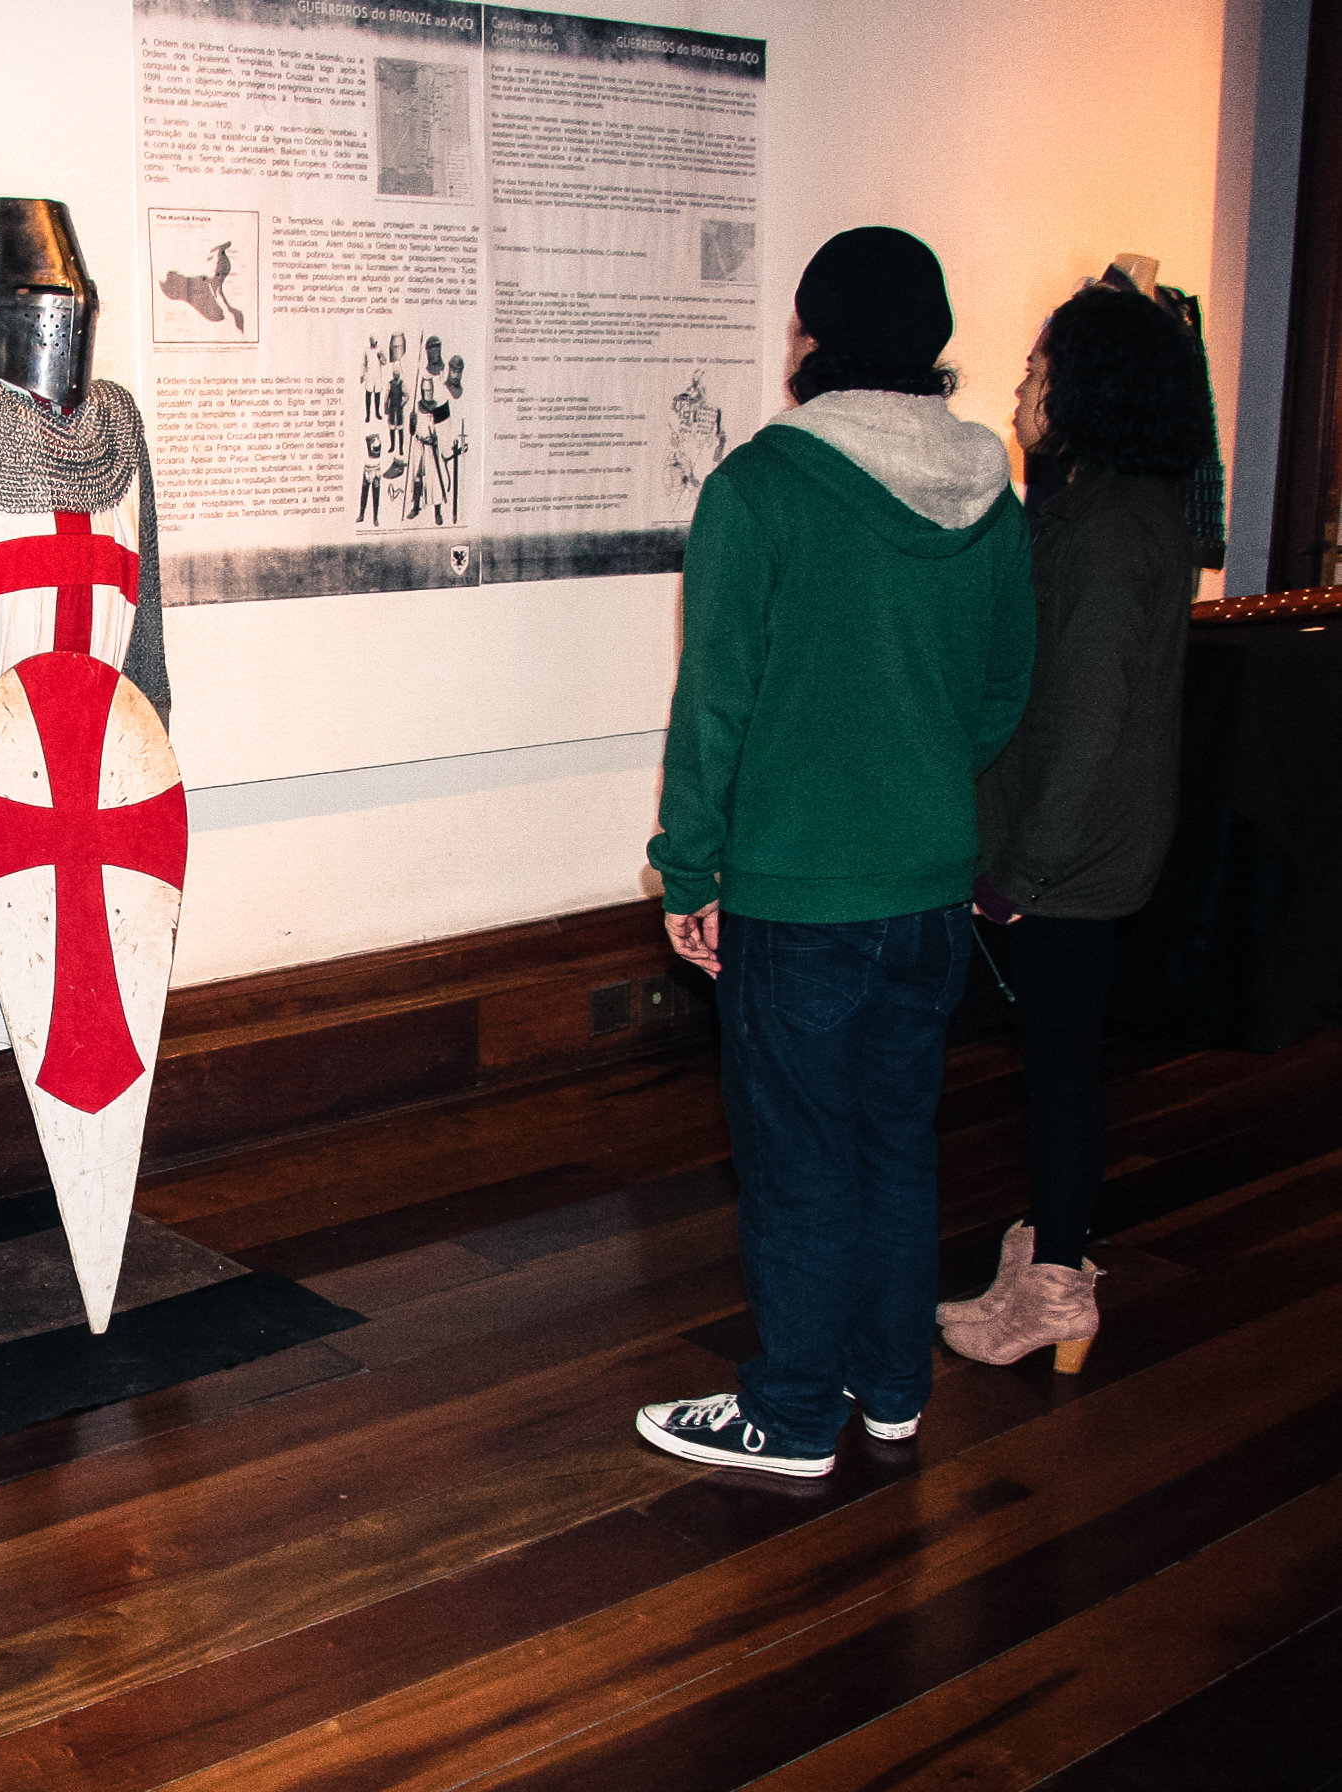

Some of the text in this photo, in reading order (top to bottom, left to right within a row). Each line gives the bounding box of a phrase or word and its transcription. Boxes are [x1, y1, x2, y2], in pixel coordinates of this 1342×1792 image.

[298, 1, 473, 30] GUERREIROS do BRONZE ao AÇO
[491, 17, 553, 35] Cavaleiros do
[490, 34, 558, 52] Oriente Médio
[616, 37, 759, 64] GUERREIROS do BRONZE ao AÇO
